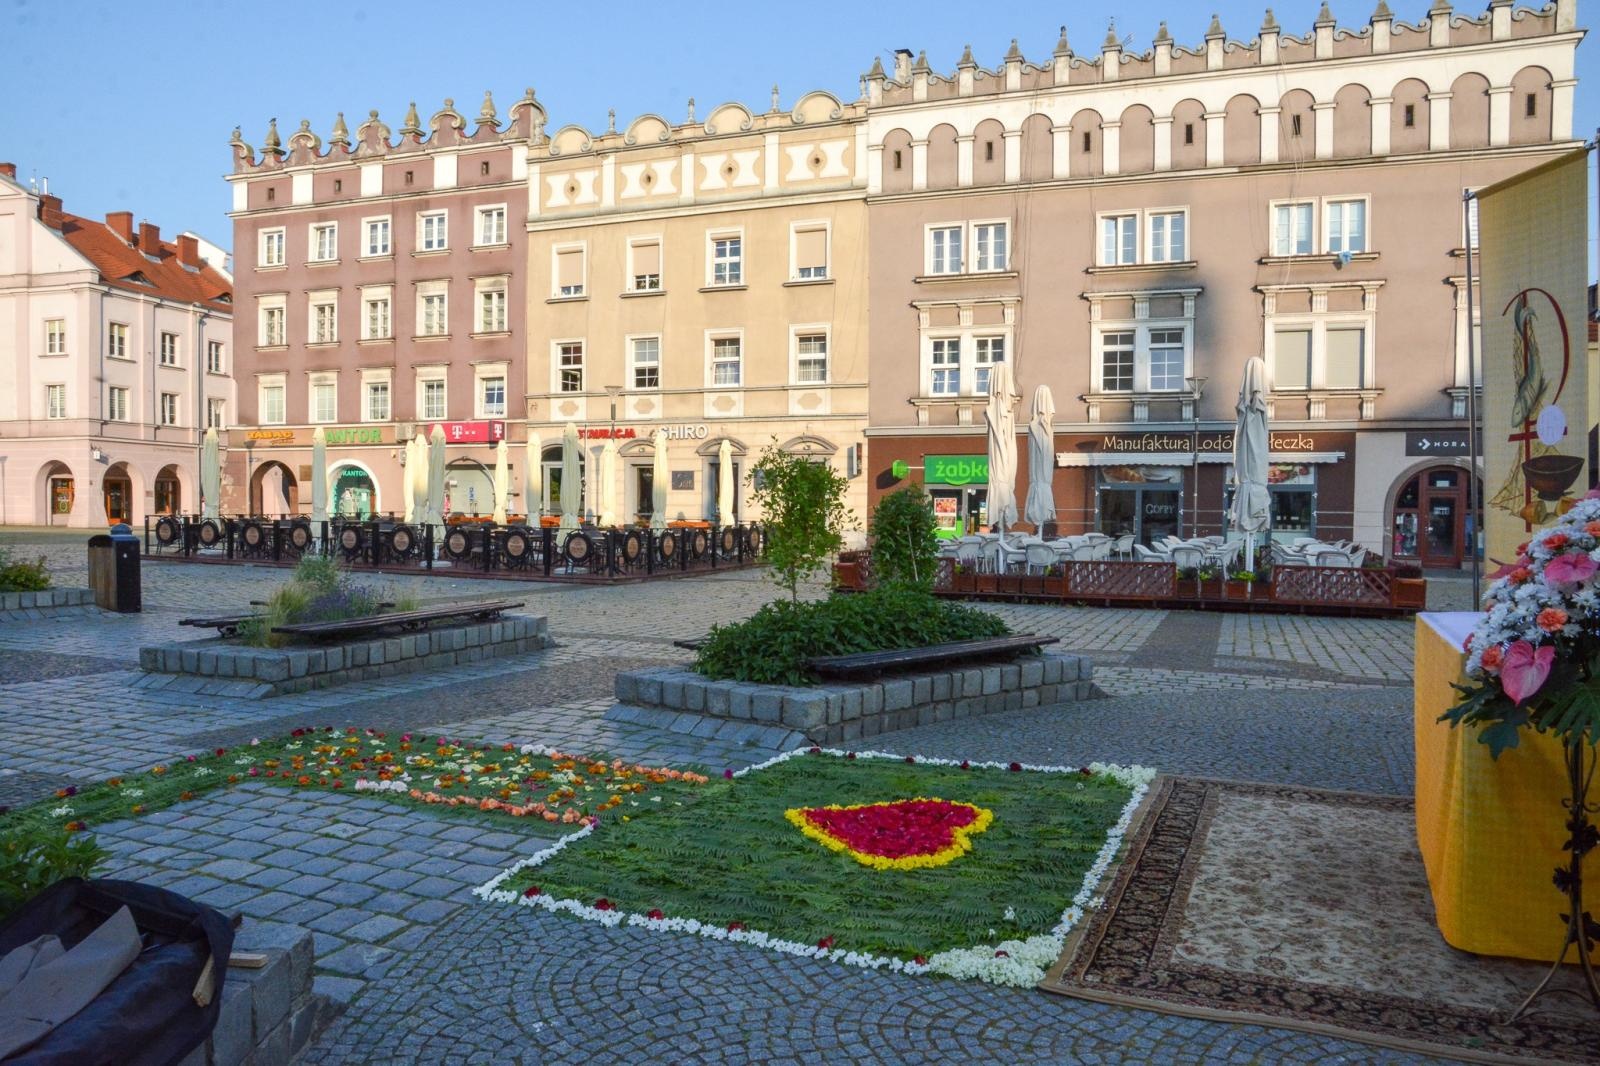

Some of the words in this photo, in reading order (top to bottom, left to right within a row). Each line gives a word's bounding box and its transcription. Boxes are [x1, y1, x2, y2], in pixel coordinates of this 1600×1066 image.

[325, 428, 383, 444] ANTOR
[661, 424, 708, 440] SHIRO
[1103, 433, 1190, 451] Manufaktura
[1197, 434, 1234, 451] Lodó
[1269, 432, 1314, 451] łeczka
